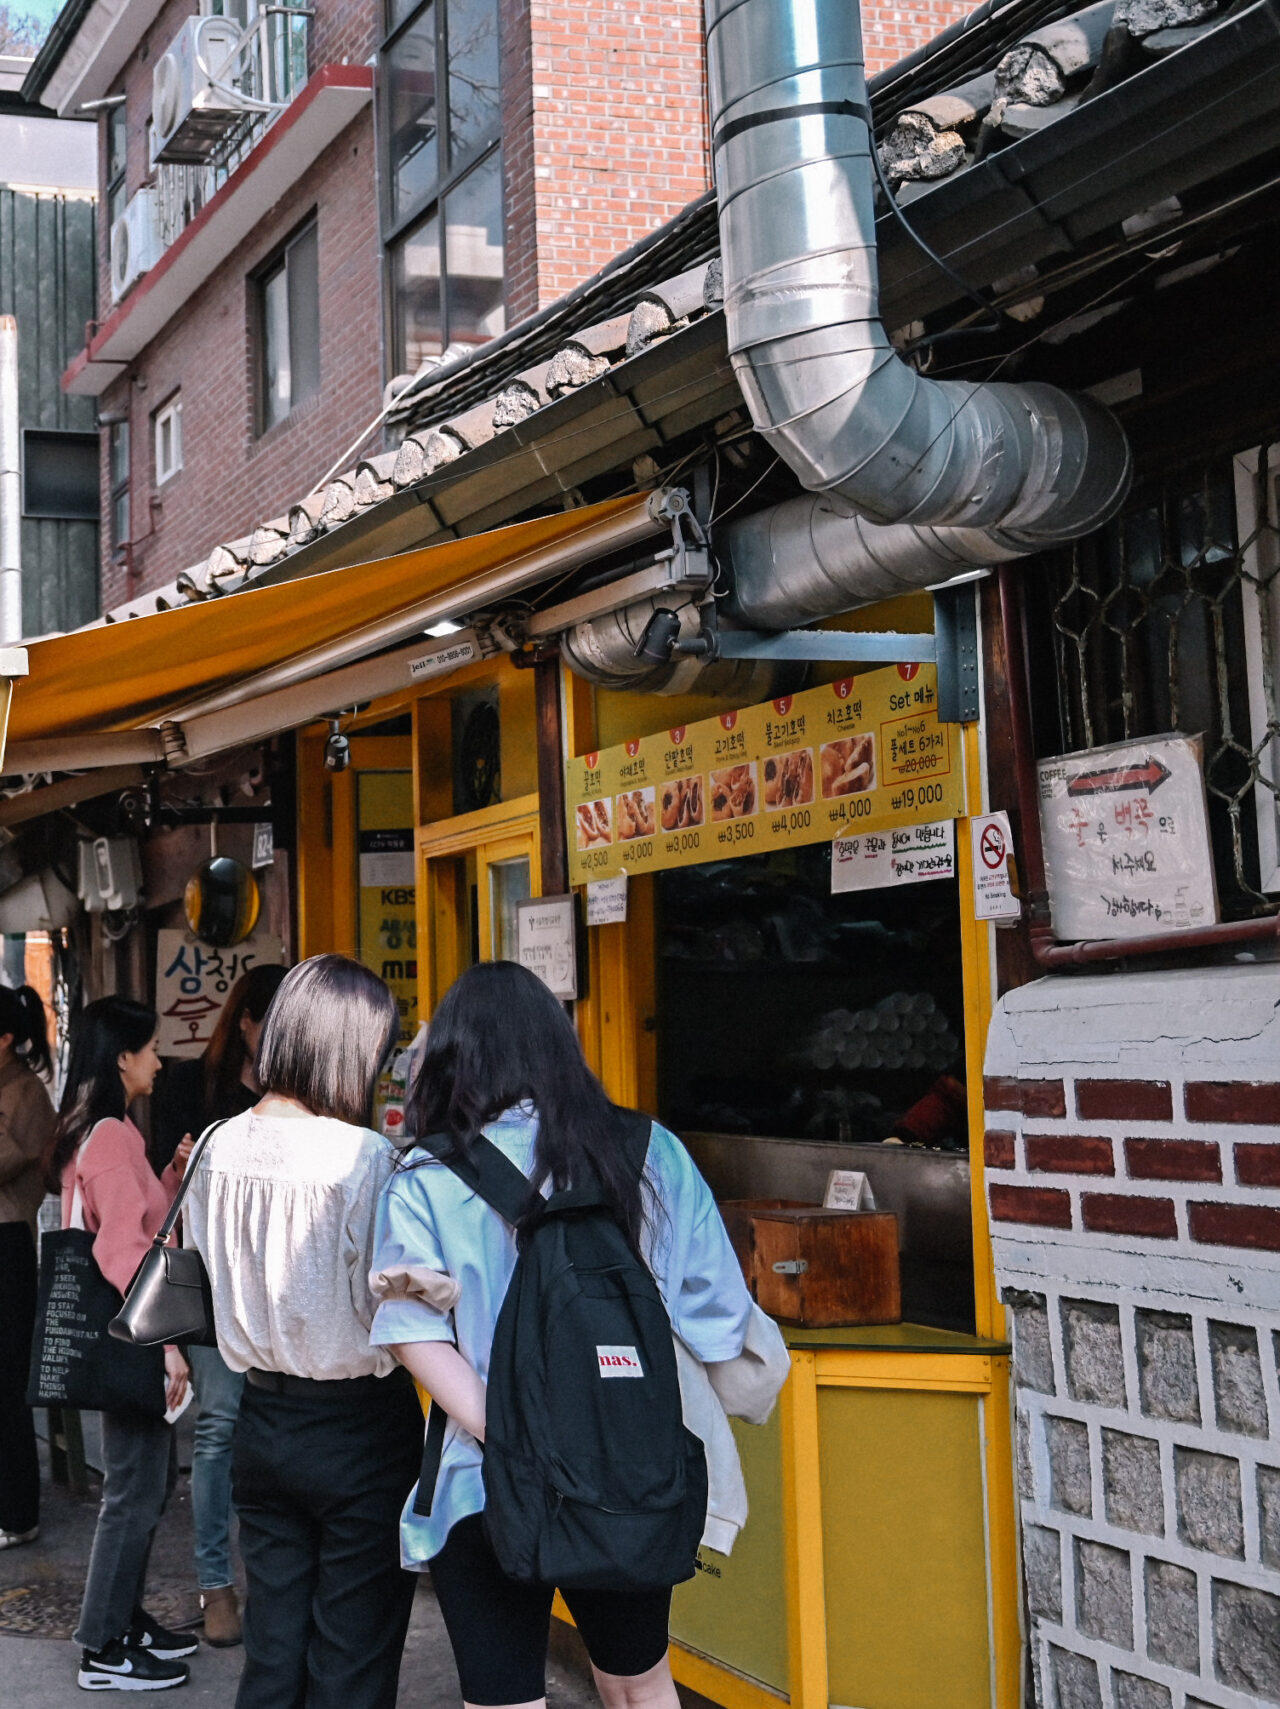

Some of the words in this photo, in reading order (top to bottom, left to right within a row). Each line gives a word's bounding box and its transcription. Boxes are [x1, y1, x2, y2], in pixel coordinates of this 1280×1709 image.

[905, 664, 912, 680] 7
[840, 683, 847, 697] 6
[889, 691, 911, 711] Set
[914, 684, 935, 704] 메뉴
[780, 701, 786, 714] 5
[827, 700, 862, 725] 치즈호떡
[725, 717, 732, 729] 4
[766, 715, 806, 746] 불고기호떡
[675, 731, 680, 743] 3
[714, 731, 745, 754] 고기호떡
[891, 738, 916, 762] 풀세트
[919, 732, 944, 751] 6가지
[664, 744, 693, 770] 단팥호떡
[620, 758, 645, 779] 야채호떡
[1039, 768, 1067, 781] COFFEE
[892, 783, 943, 811] ₩19,000
[829, 798, 872, 823] ₩4,000
[772, 810, 811, 835] ₩4,000
[718, 821, 754, 846] ₩3,500
[623, 842, 653, 862] ₩3,000
[666, 832, 700, 855] ₩3,000
[864, 837, 886, 852] 주문과
[581, 851, 608, 870] ₩2,500
[381, 889, 416, 906] KBS
[47, 1301, 56, 1309] TO
[57, 1302, 75, 1310] STAY
[45, 1318, 59, 1326] THE
[43, 1345, 57, 1354] THE
[44, 1337, 53, 1345] TO
[40, 1365, 50, 1373] TO
